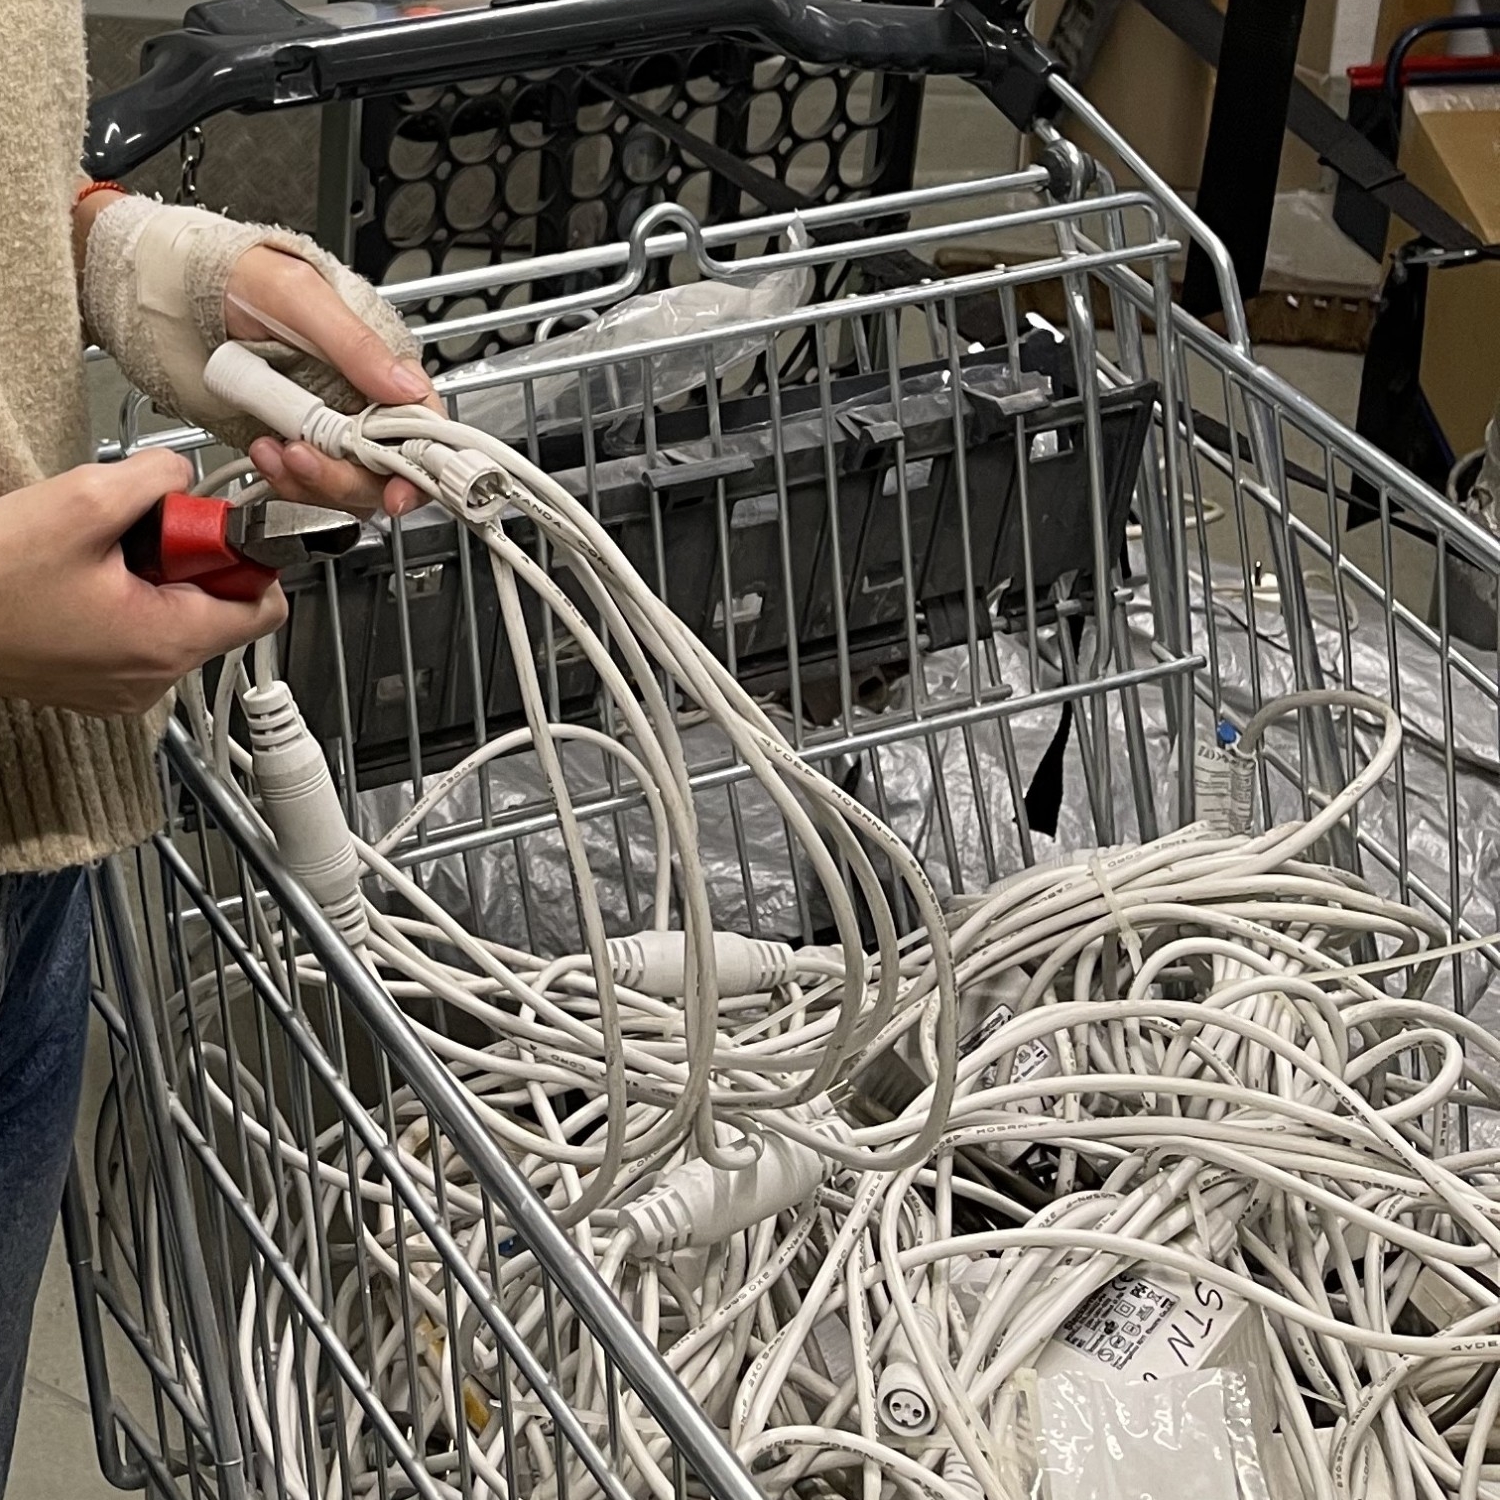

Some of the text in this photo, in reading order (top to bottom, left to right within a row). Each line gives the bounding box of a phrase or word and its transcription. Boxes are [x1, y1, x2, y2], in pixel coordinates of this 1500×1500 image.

[511, 490, 562, 528] WANDA
[550, 1054, 586, 1071] CORD
[861, 1174, 883, 1214] CABLE
[1168, 1282, 1223, 1366] STN
